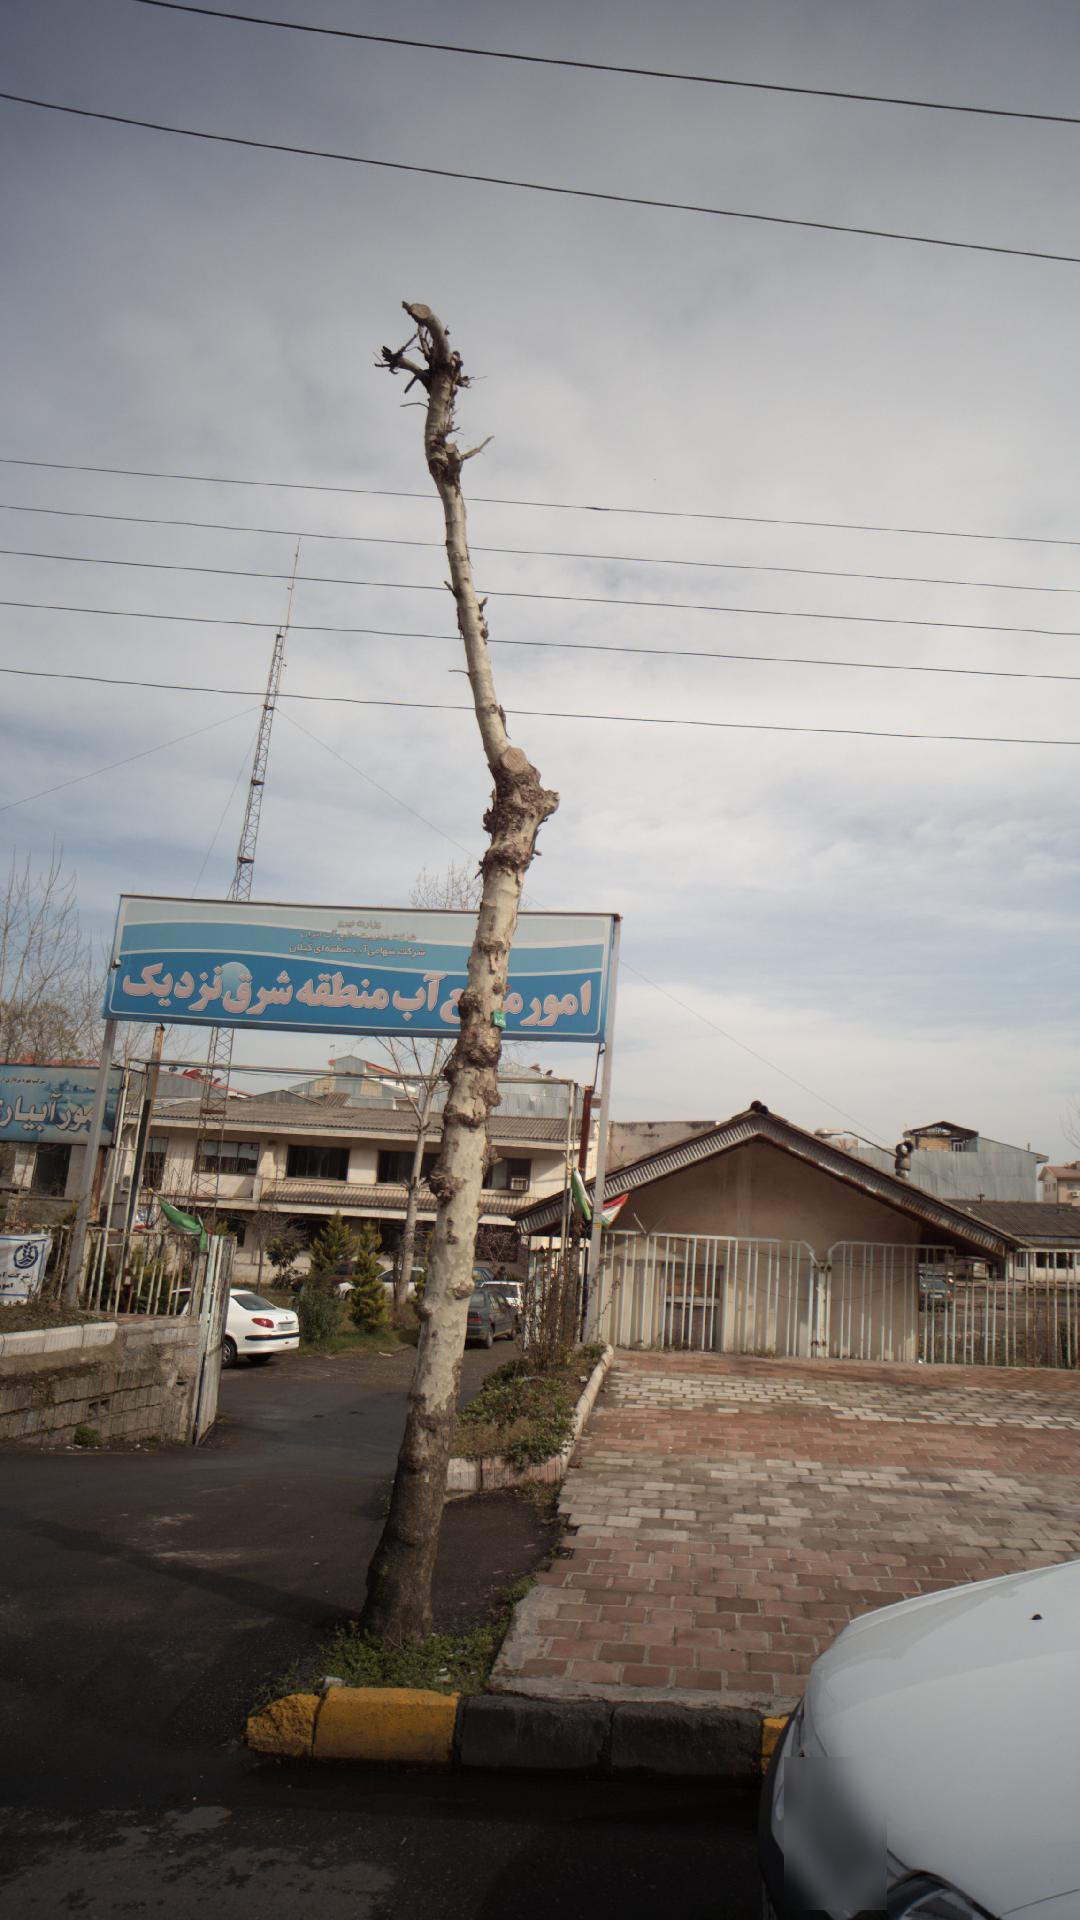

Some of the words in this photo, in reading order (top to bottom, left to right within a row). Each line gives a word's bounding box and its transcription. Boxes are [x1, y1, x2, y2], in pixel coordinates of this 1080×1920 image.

[122, 961, 224, 1012] نزدیک
[221, 969, 294, 1015] شرق
[295, 970, 390, 1010] منطقه
[392, 972, 449, 1022] آب
[519, 979, 593, 1027] امور
[55, 1106, 95, 1132] مور
